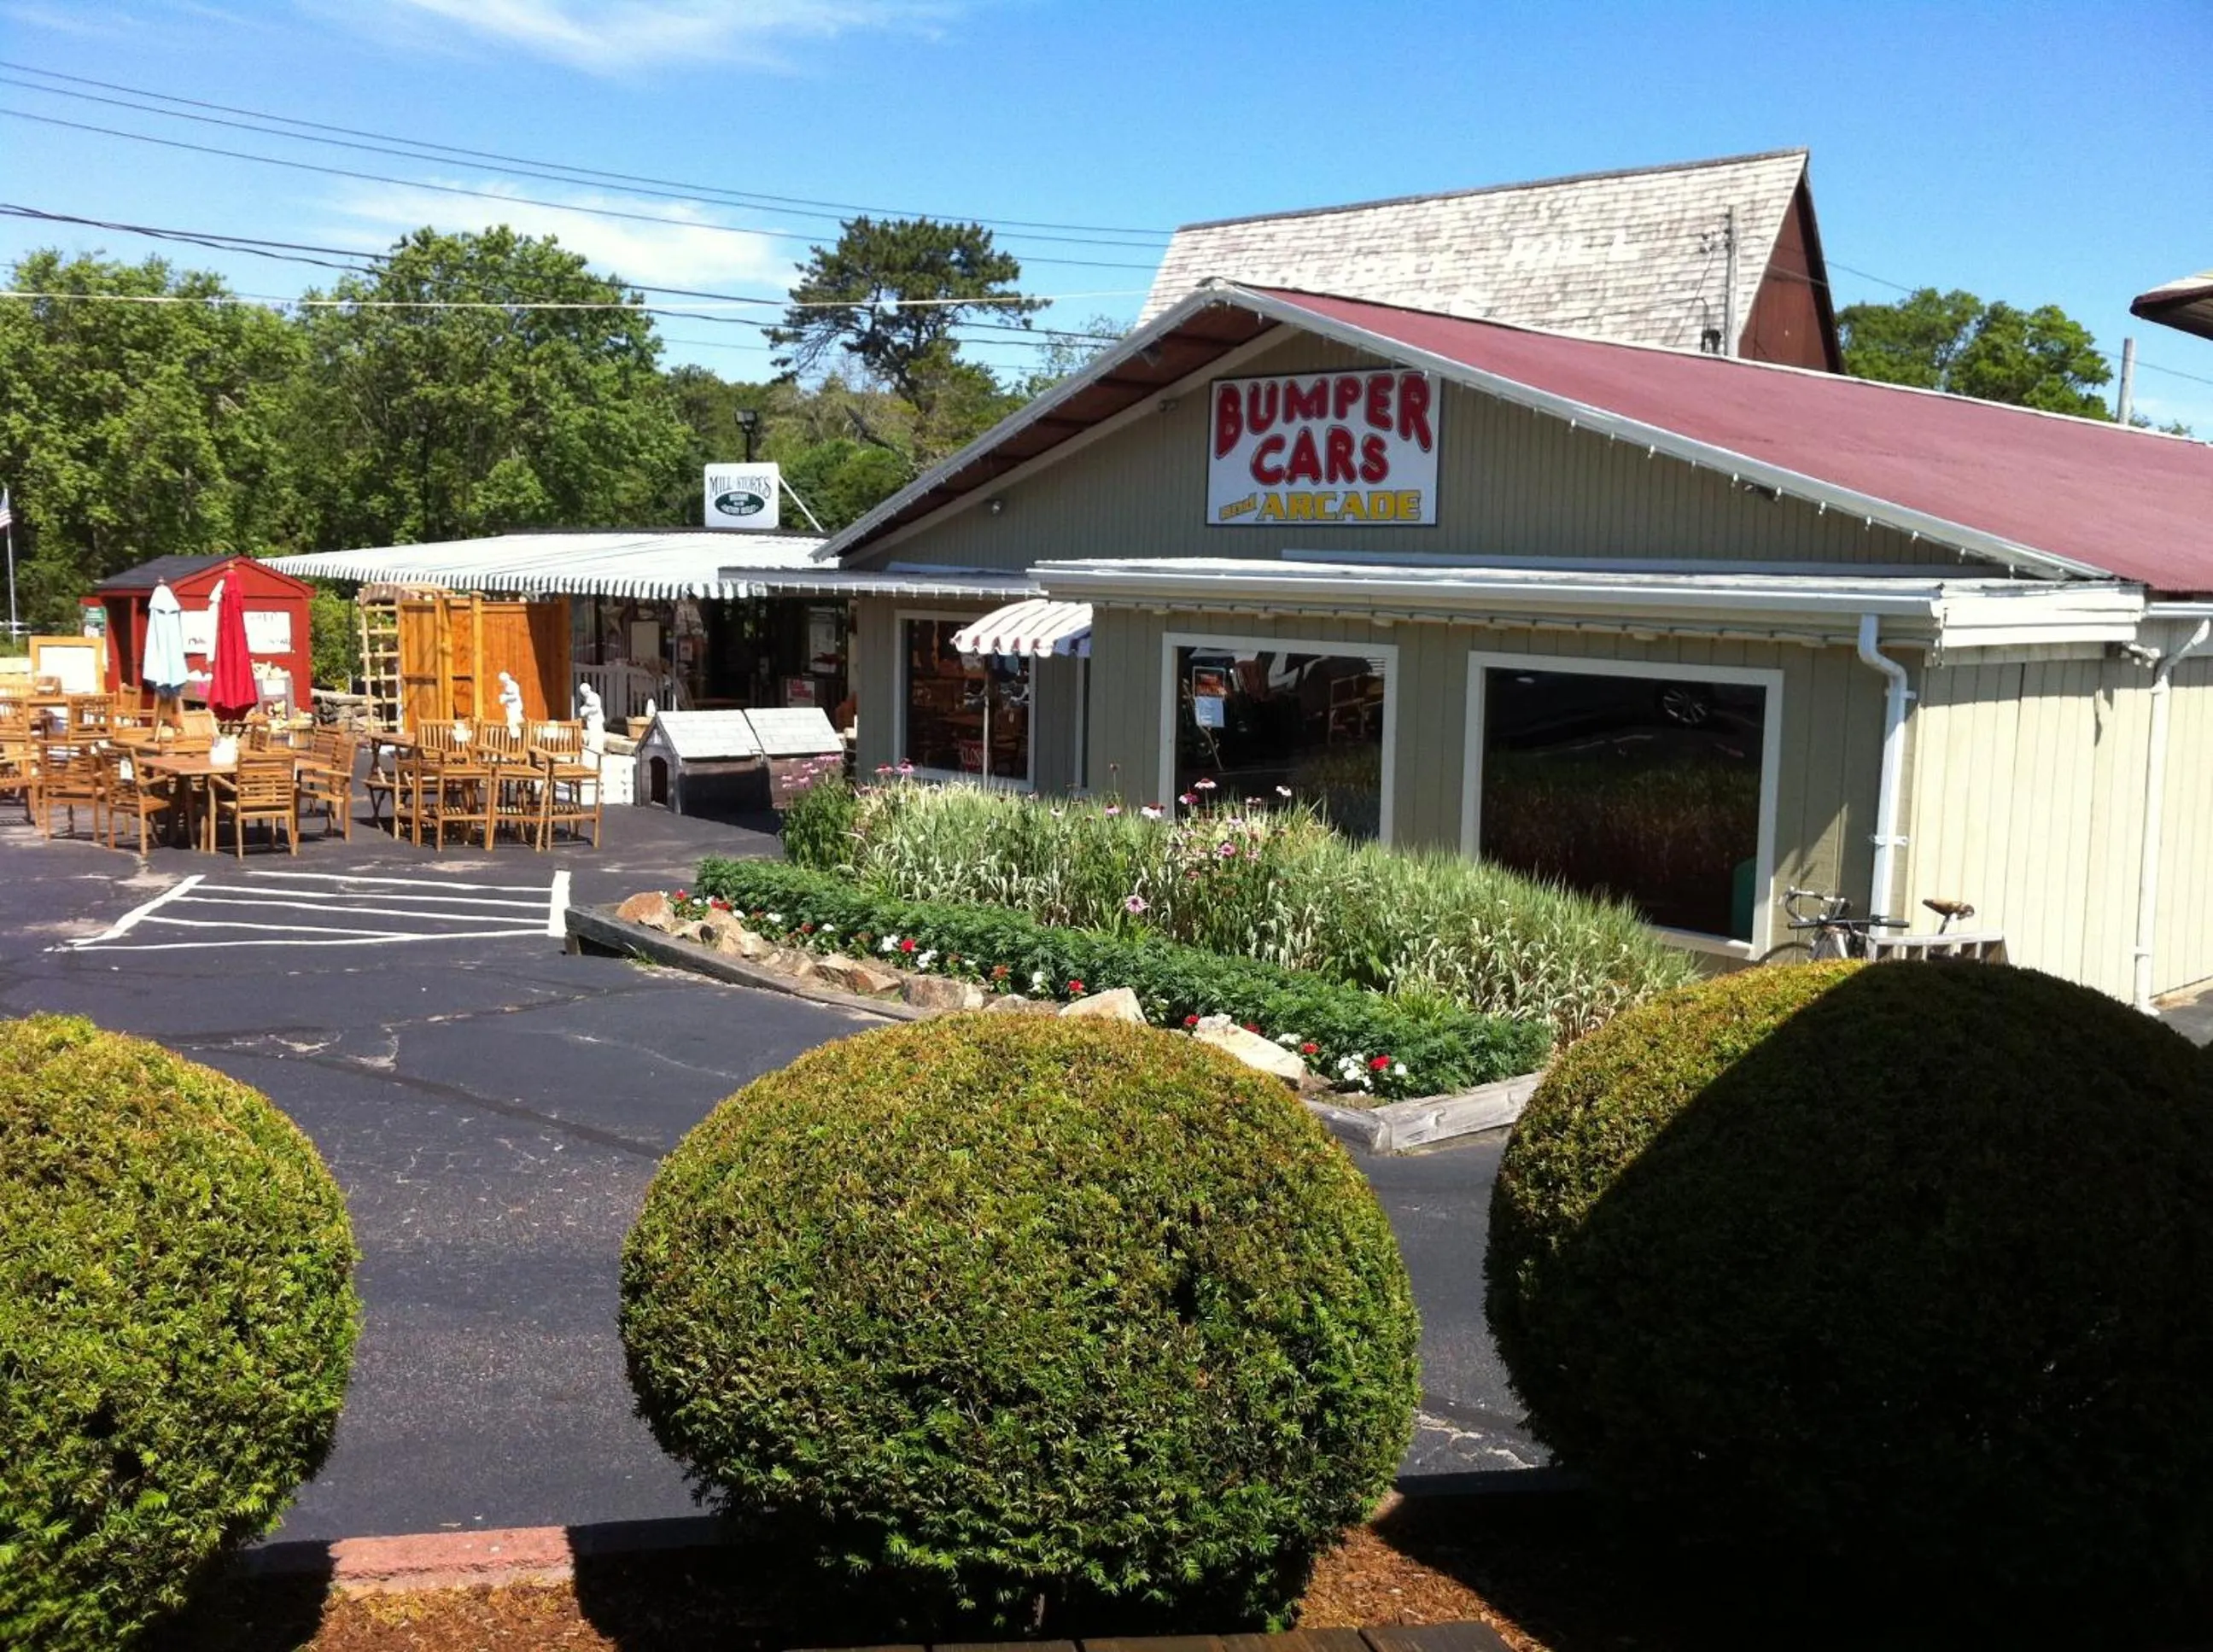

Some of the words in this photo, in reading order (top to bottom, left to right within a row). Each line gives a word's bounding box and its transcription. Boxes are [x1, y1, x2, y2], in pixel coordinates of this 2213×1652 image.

[1215, 371, 1432, 460] BUMPER
[1250, 424, 1389, 486] CARS
[709, 475, 733, 499] MILL
[1256, 489, 1422, 522] ARCADE
